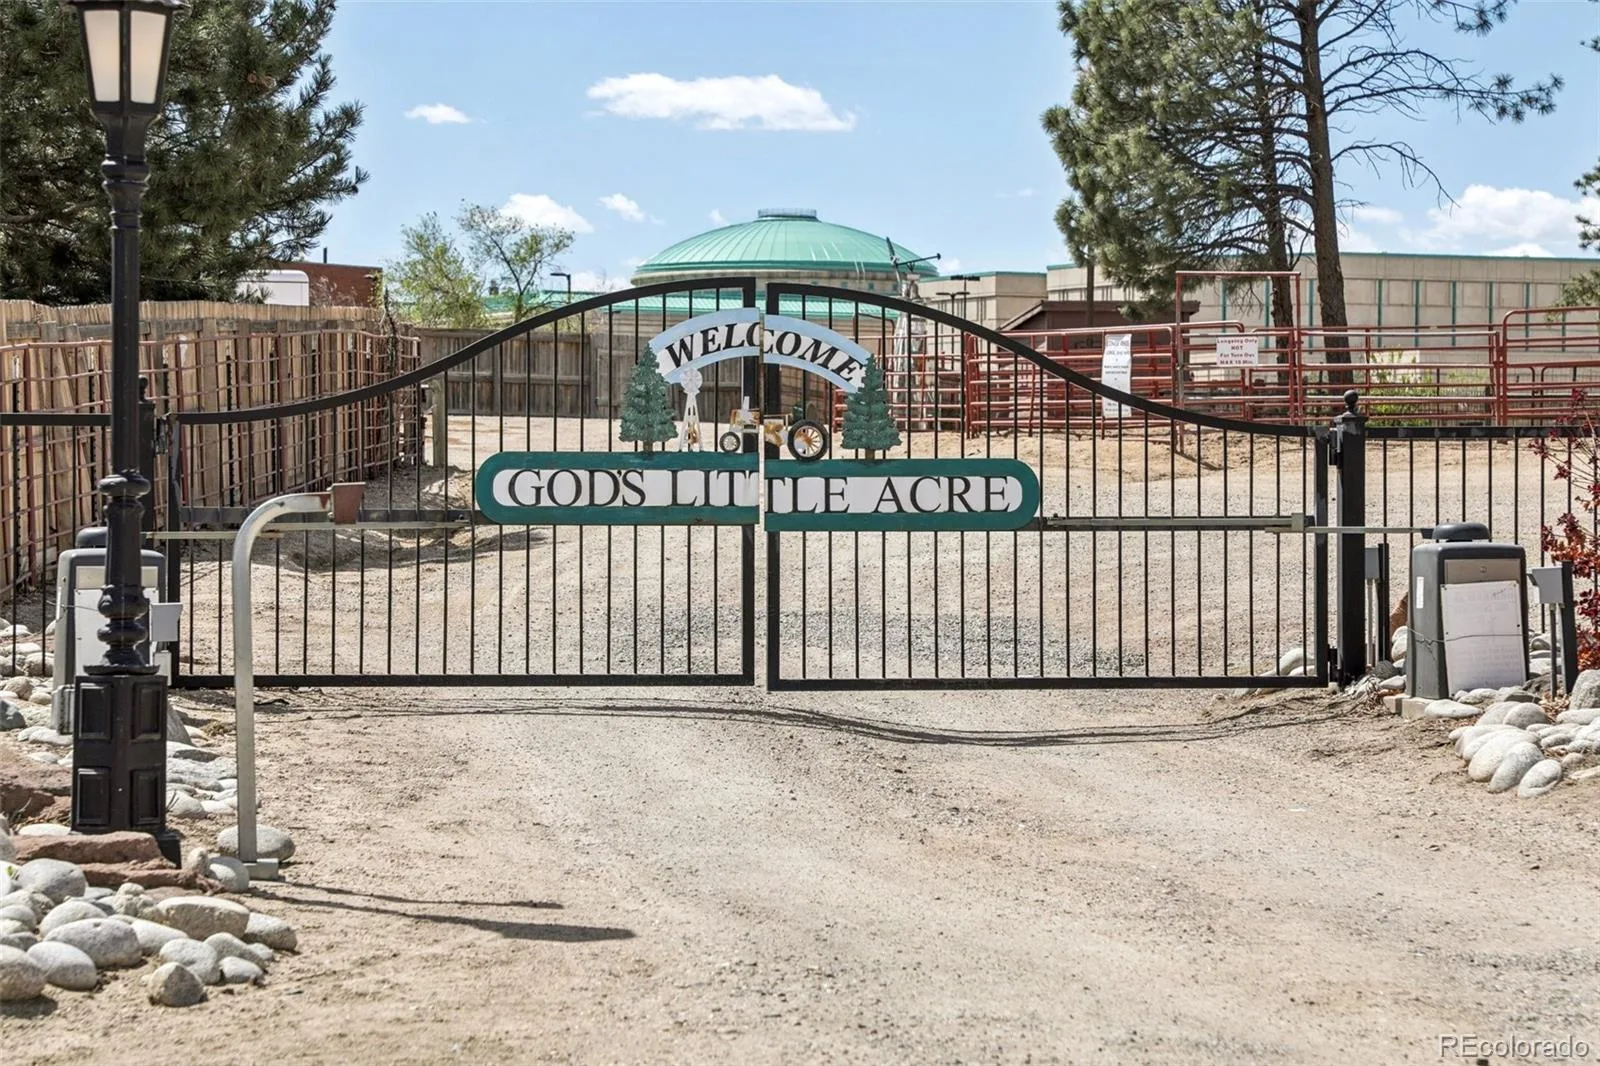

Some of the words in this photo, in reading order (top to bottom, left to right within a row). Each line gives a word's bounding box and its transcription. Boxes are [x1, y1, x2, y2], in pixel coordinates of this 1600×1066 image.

[665, 322, 864, 382] WELCOME
[507, 469, 647, 508] GOD'S
[669, 469, 851, 515] LITTLE
[873, 475, 1011, 514] ACRE
